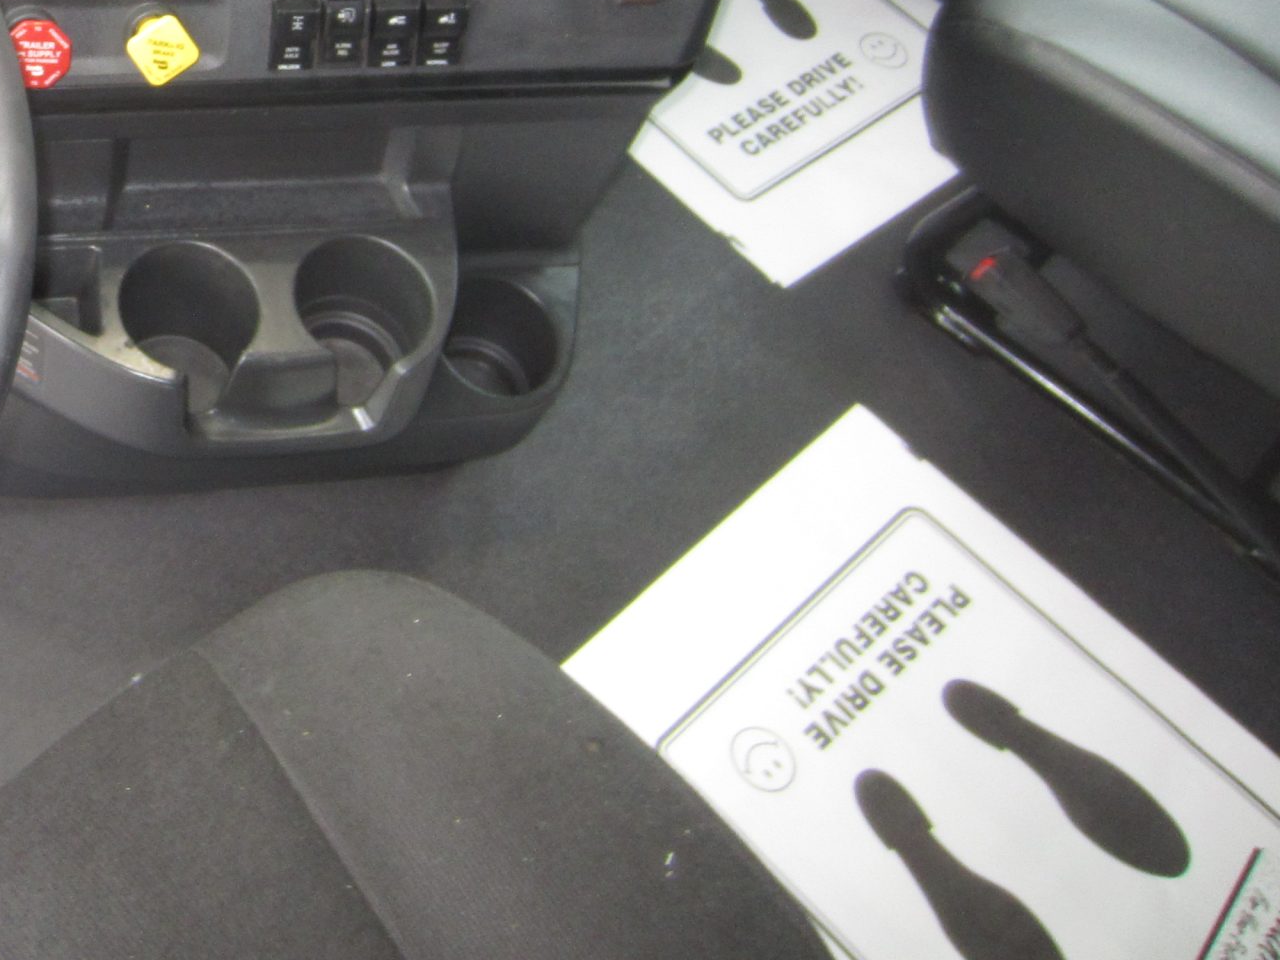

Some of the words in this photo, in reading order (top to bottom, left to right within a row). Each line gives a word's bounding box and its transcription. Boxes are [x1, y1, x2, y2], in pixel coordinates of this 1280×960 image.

[707, 90, 790, 145] PLEASE
[786, 52, 854, 97] DRIVE
[739, 76, 865, 157] CAREFULLY!
[786, 571, 929, 709] CAREFULLY!
[877, 584, 972, 676] PLEASE
[803, 670, 885, 750] DRIVE
